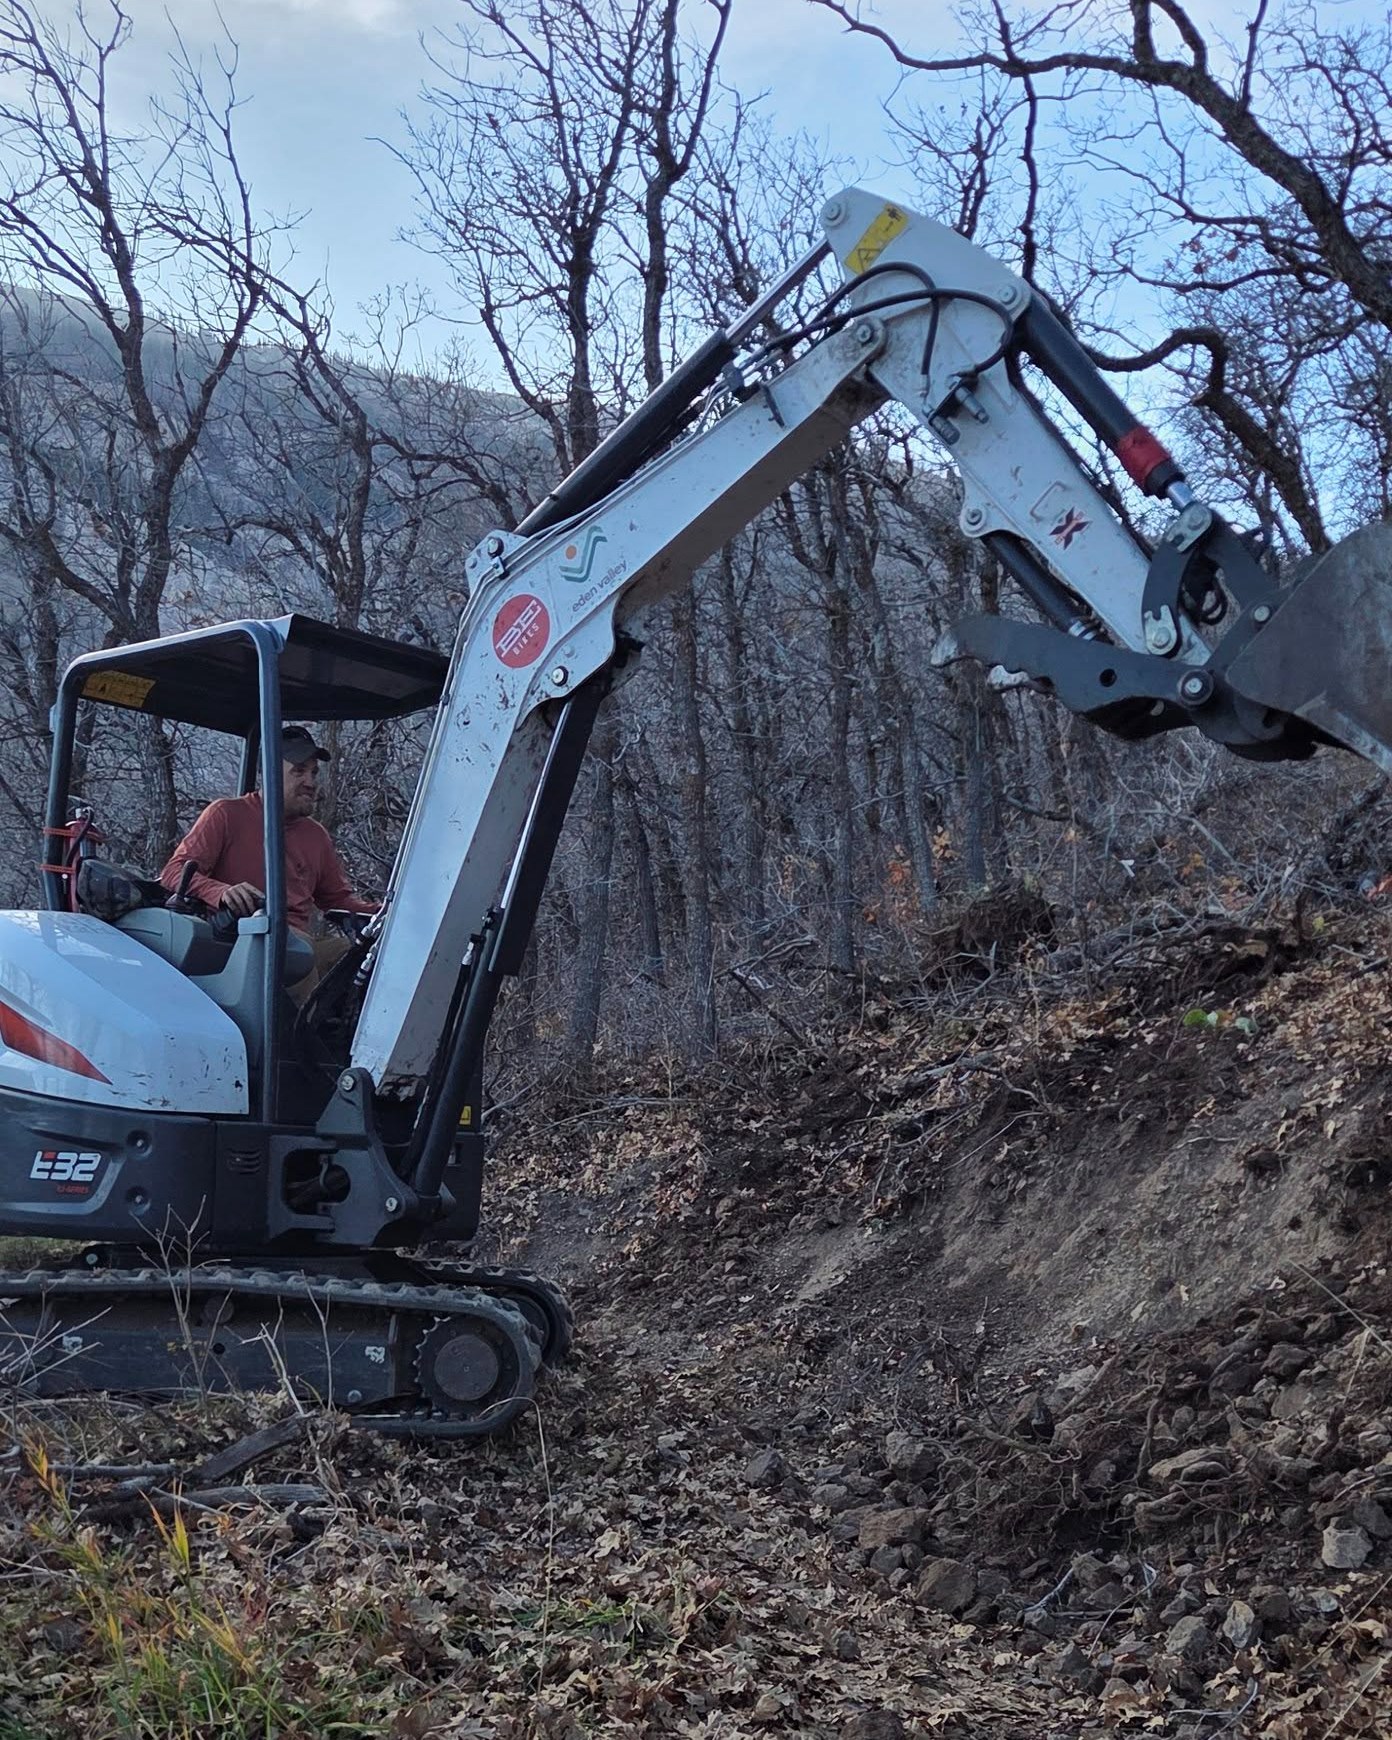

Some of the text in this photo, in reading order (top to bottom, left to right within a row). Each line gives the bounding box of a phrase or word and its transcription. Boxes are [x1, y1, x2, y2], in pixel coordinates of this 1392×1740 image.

[572, 559, 627, 612] eden valley
[30, 1151, 101, 1182] E32
